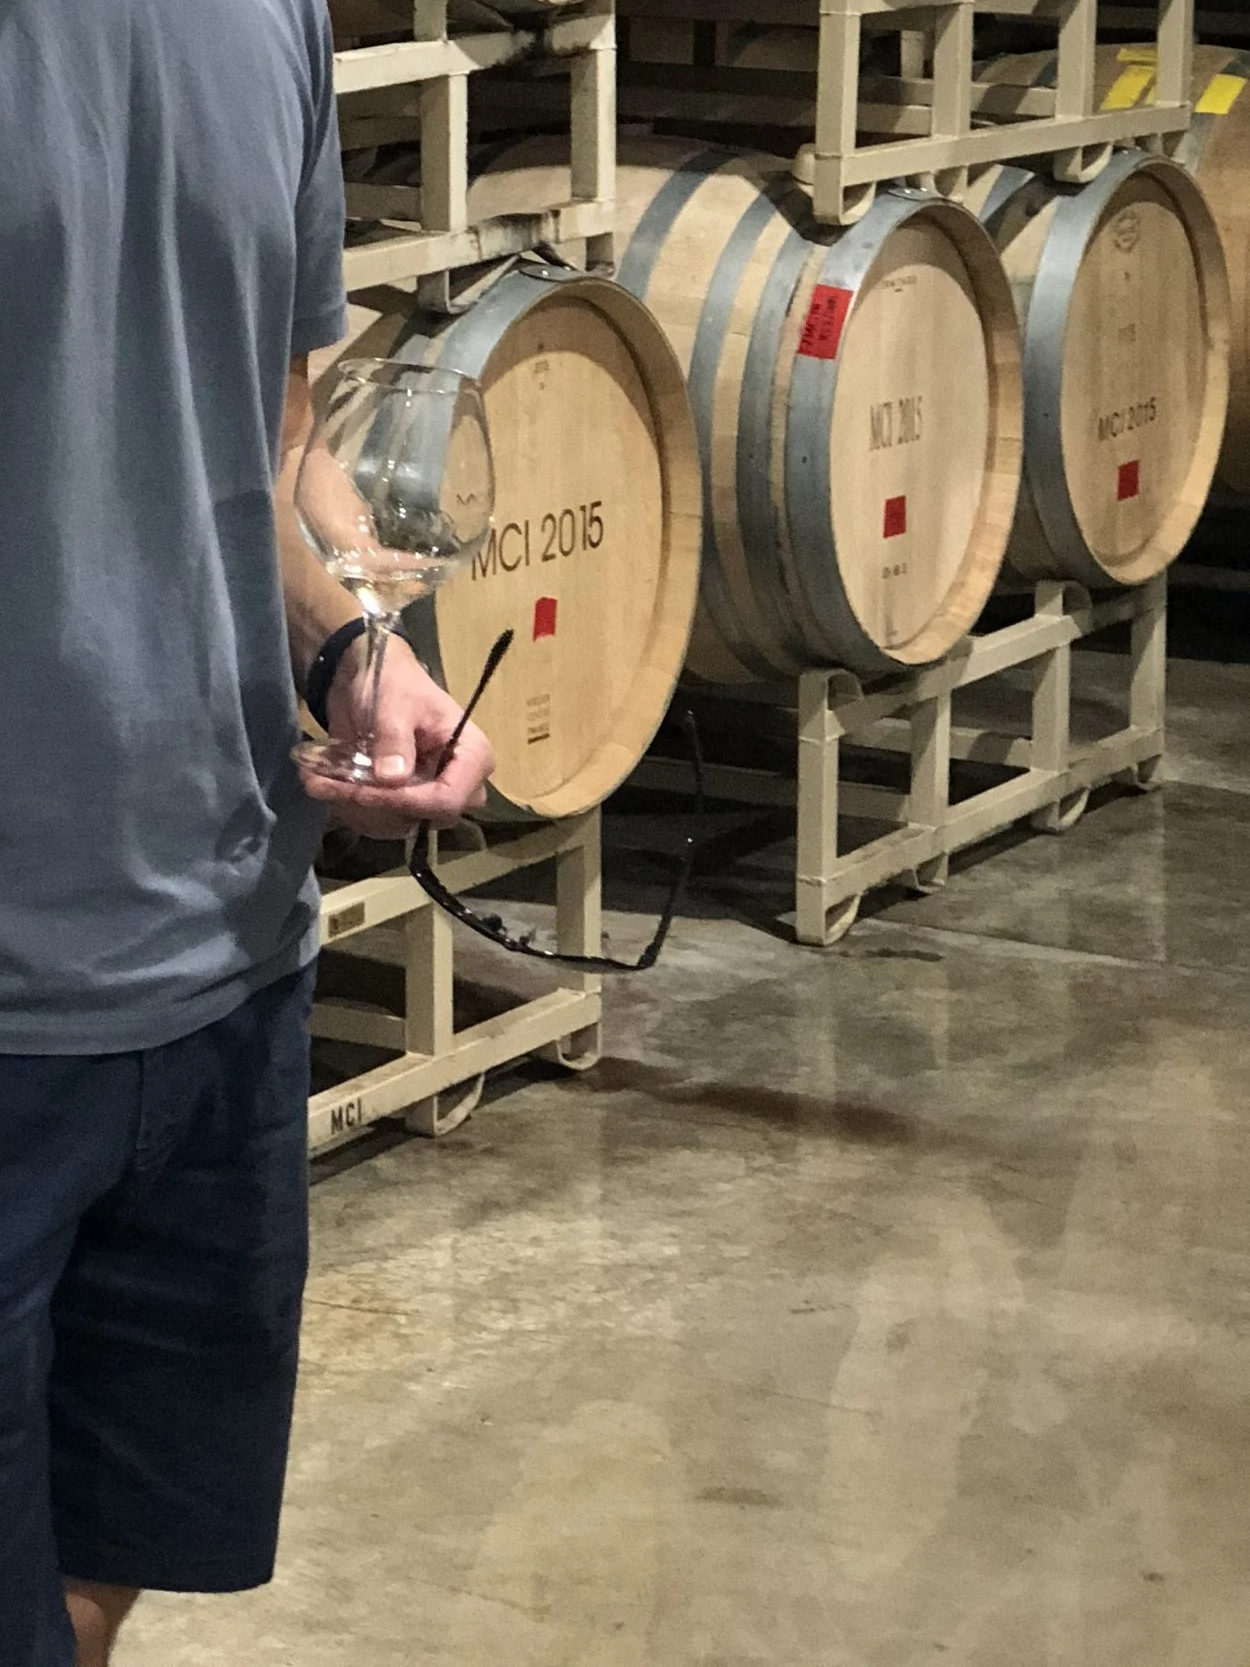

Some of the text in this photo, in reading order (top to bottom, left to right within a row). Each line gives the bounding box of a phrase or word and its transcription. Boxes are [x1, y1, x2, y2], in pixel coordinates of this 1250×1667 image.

[471, 500, 604, 581] MCI 2015
[331, 1096, 362, 1135] MCI
